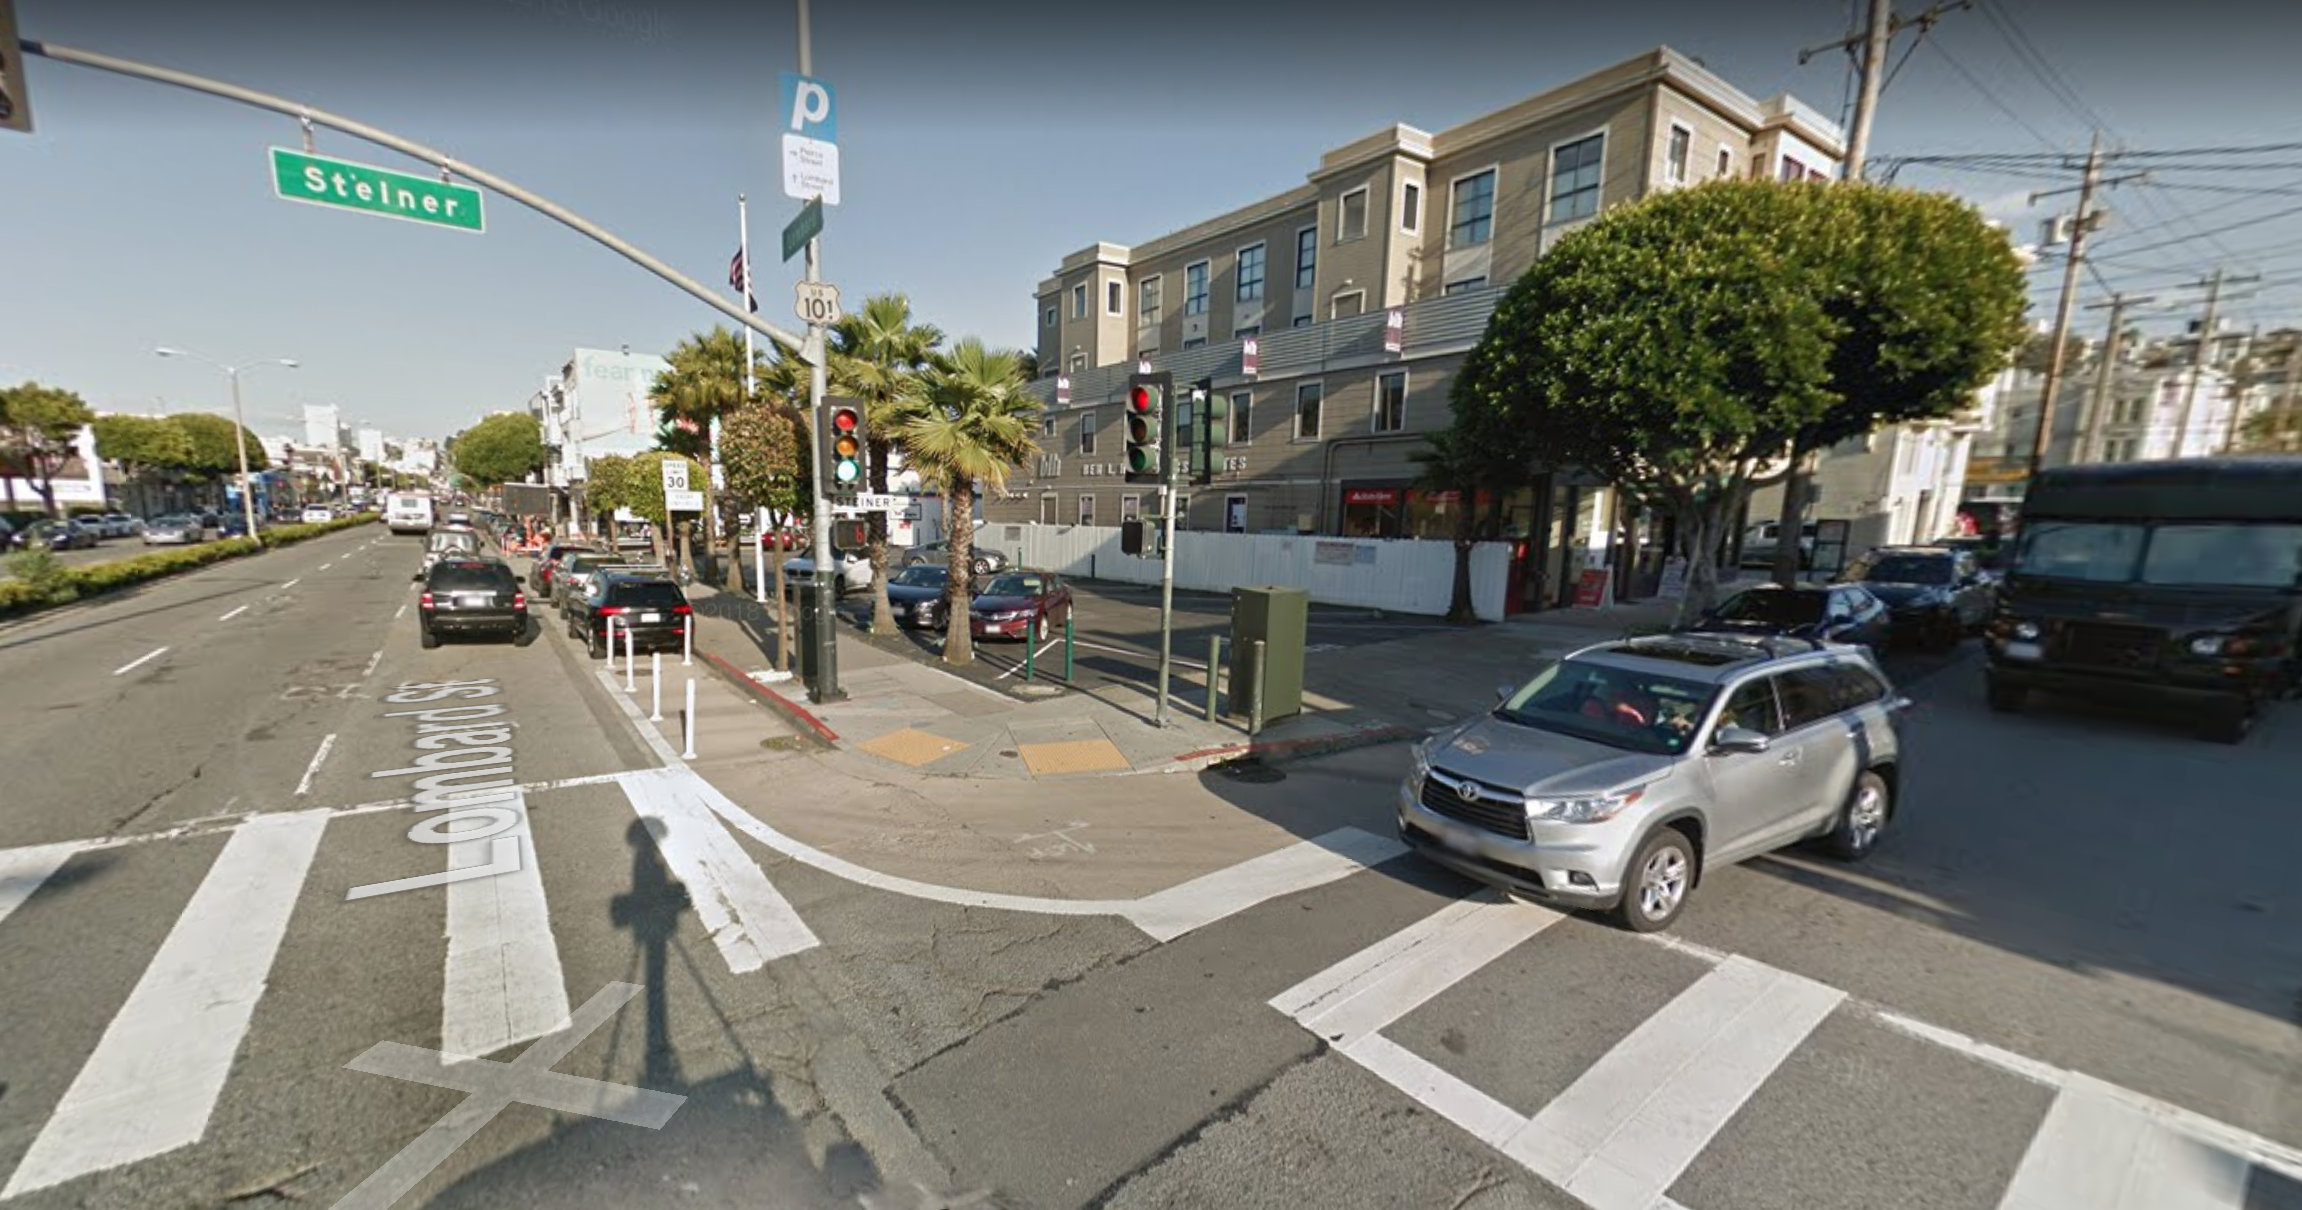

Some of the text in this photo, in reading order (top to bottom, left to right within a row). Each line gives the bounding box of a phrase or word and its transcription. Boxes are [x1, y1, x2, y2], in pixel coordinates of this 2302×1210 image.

[303, 165, 459, 217] Steiner
[811, 288, 824, 298] US
[804, 297, 833, 320] 101
[667, 476, 685, 488] 30
[836, 497, 890, 507] STEINER
